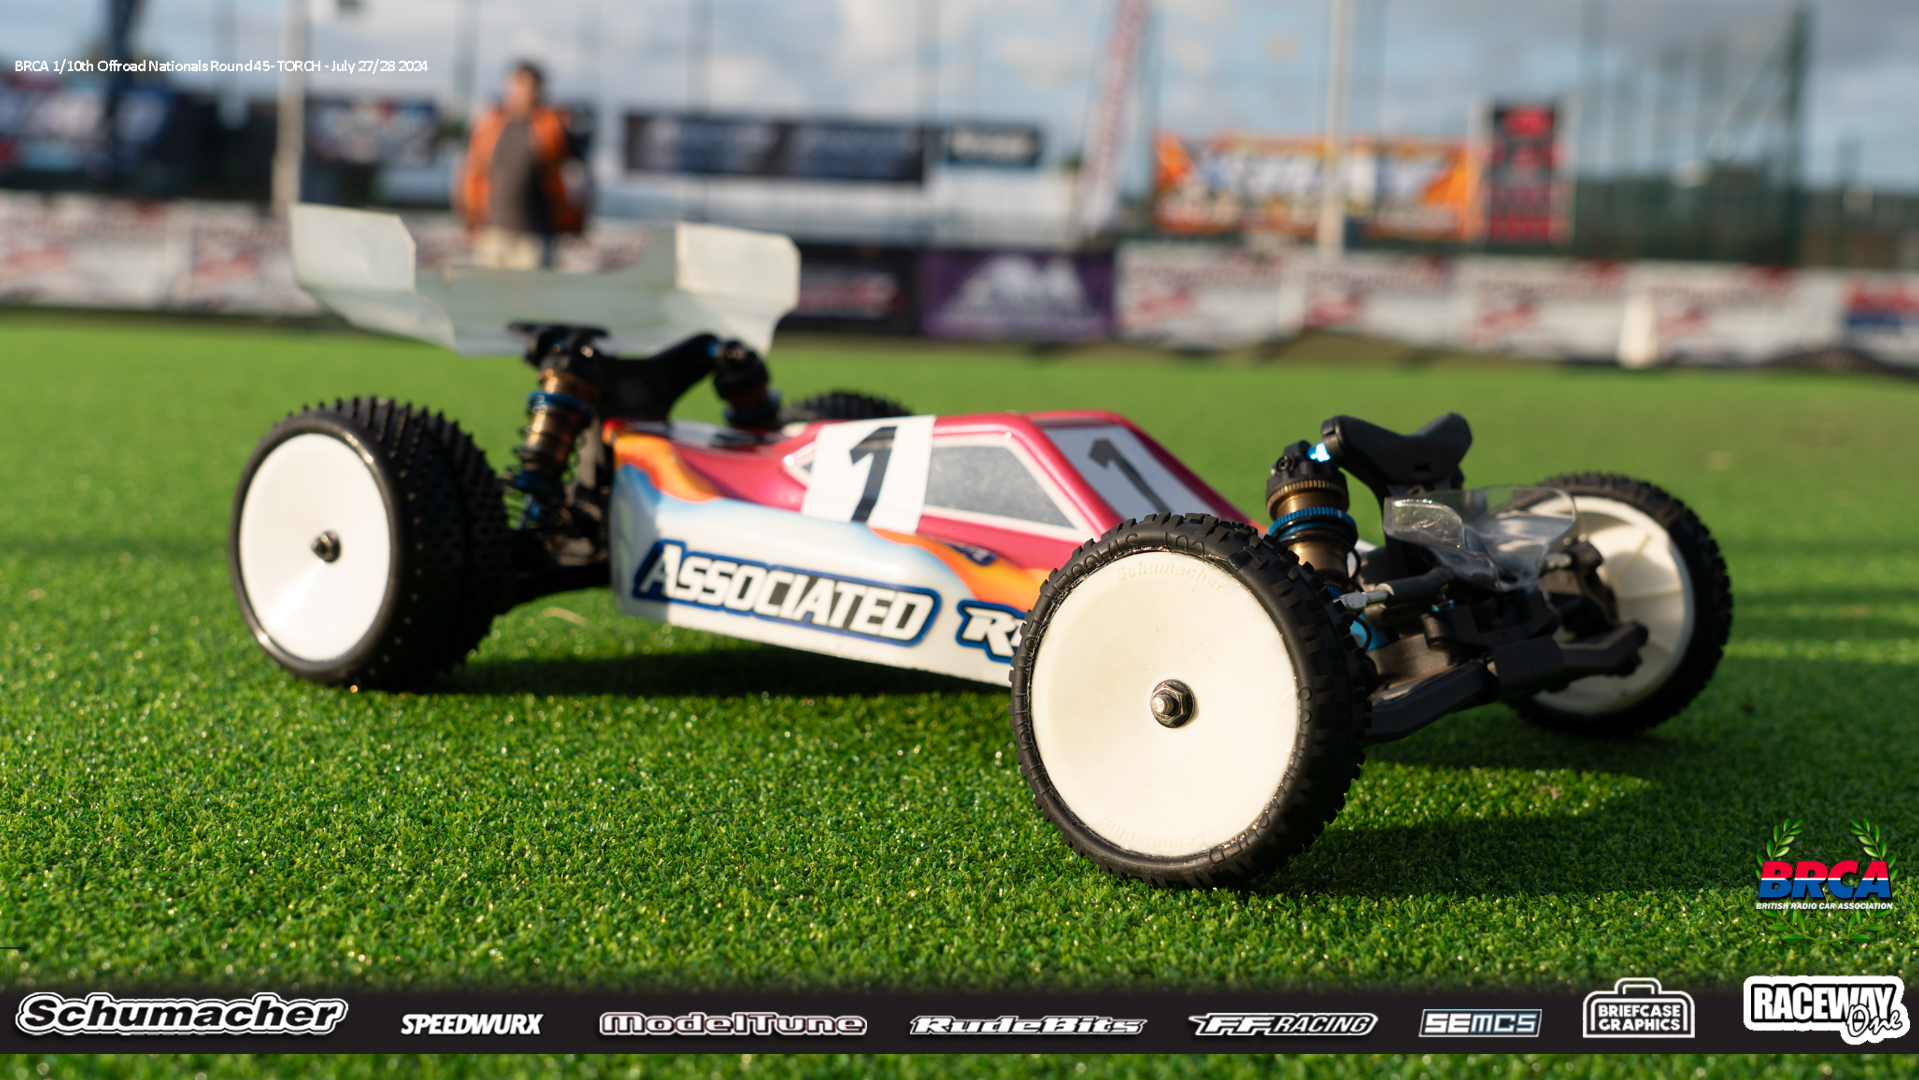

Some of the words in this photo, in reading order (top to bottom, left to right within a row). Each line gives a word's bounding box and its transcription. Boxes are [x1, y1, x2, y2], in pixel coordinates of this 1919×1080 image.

[849, 423, 898, 523] 1
[1088, 437, 1173, 513] 1
[638, 544, 935, 642] ASSOCIATED
[1116, 561, 1228, 592] Schumacher
